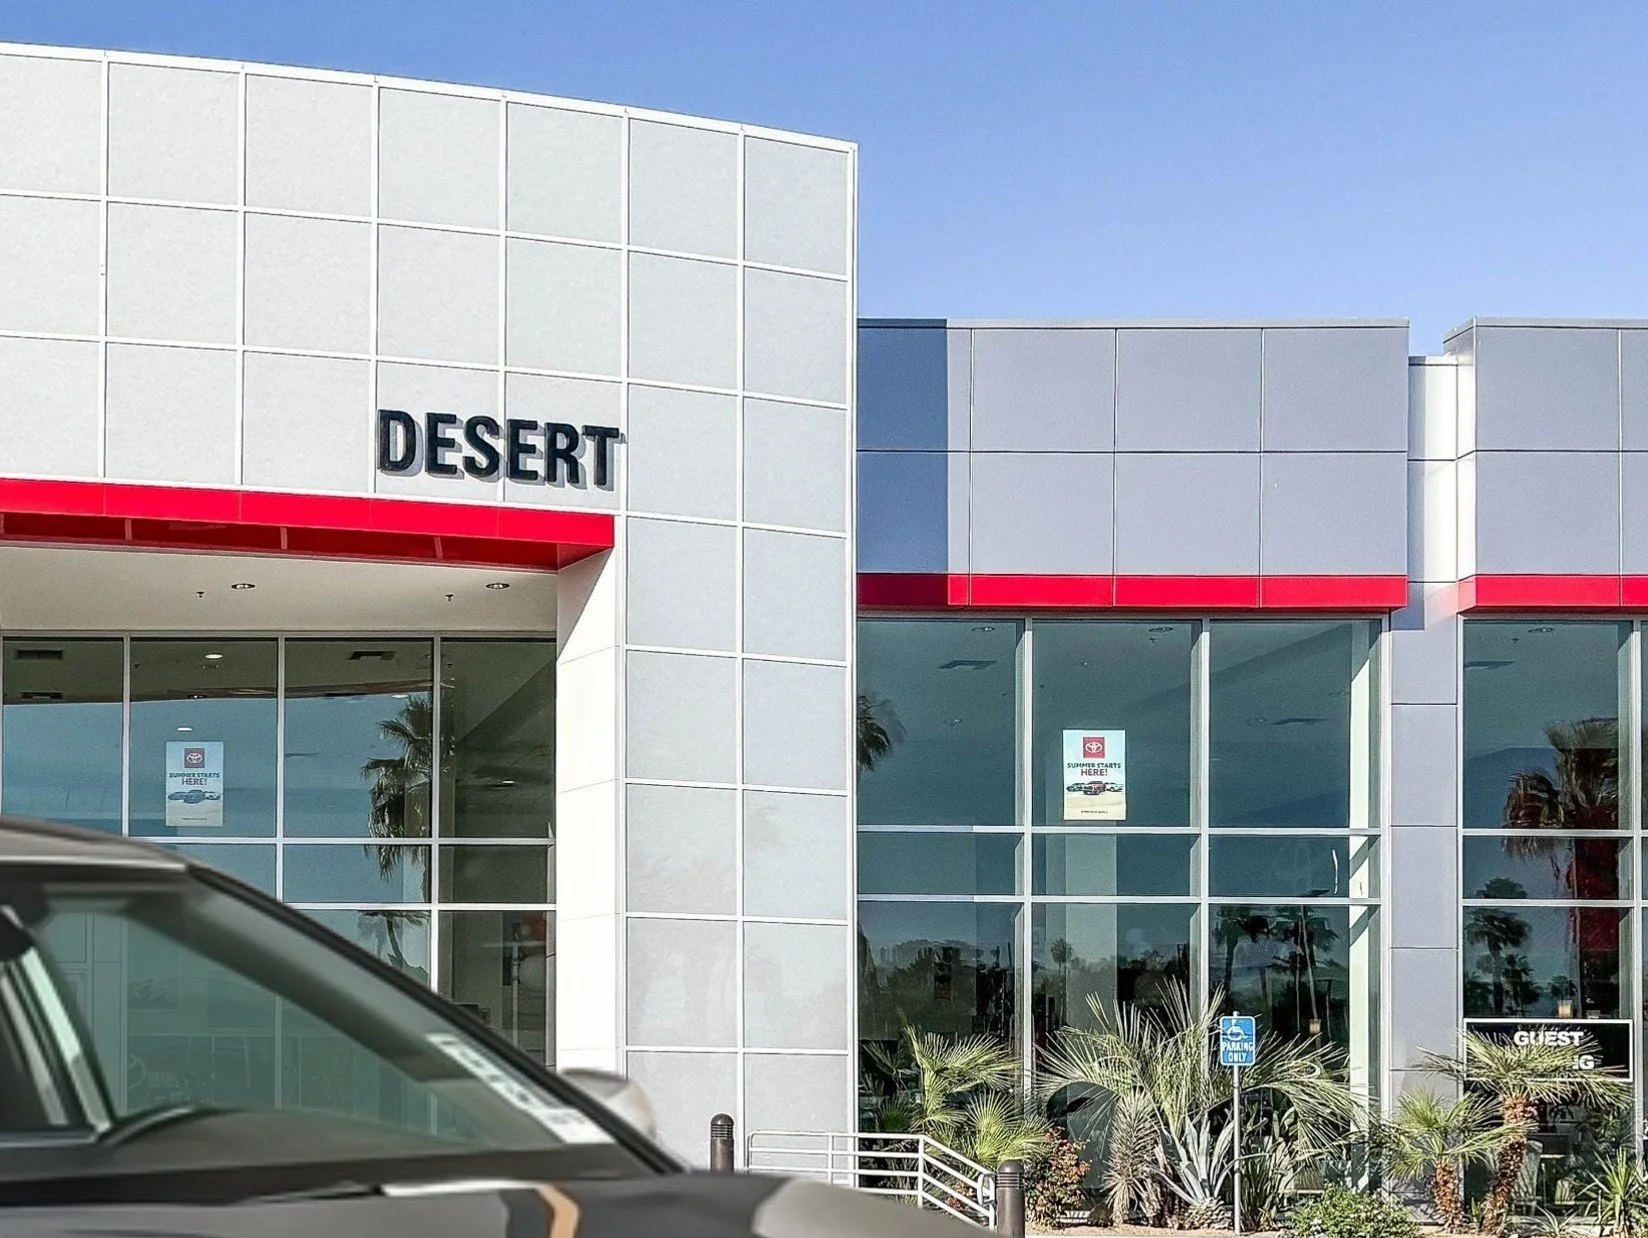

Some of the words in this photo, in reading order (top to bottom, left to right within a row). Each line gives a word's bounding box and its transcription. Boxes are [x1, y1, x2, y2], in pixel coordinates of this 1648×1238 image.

[376, 408, 620, 486] DESERT
[1080, 768, 1108, 776] HERE!
[181, 778, 207, 786] HERE!
[1513, 1030, 1584, 1047] GUEST
[1222, 1040, 1253, 1052] PARKING
[1228, 1051, 1247, 1062] ONLY
